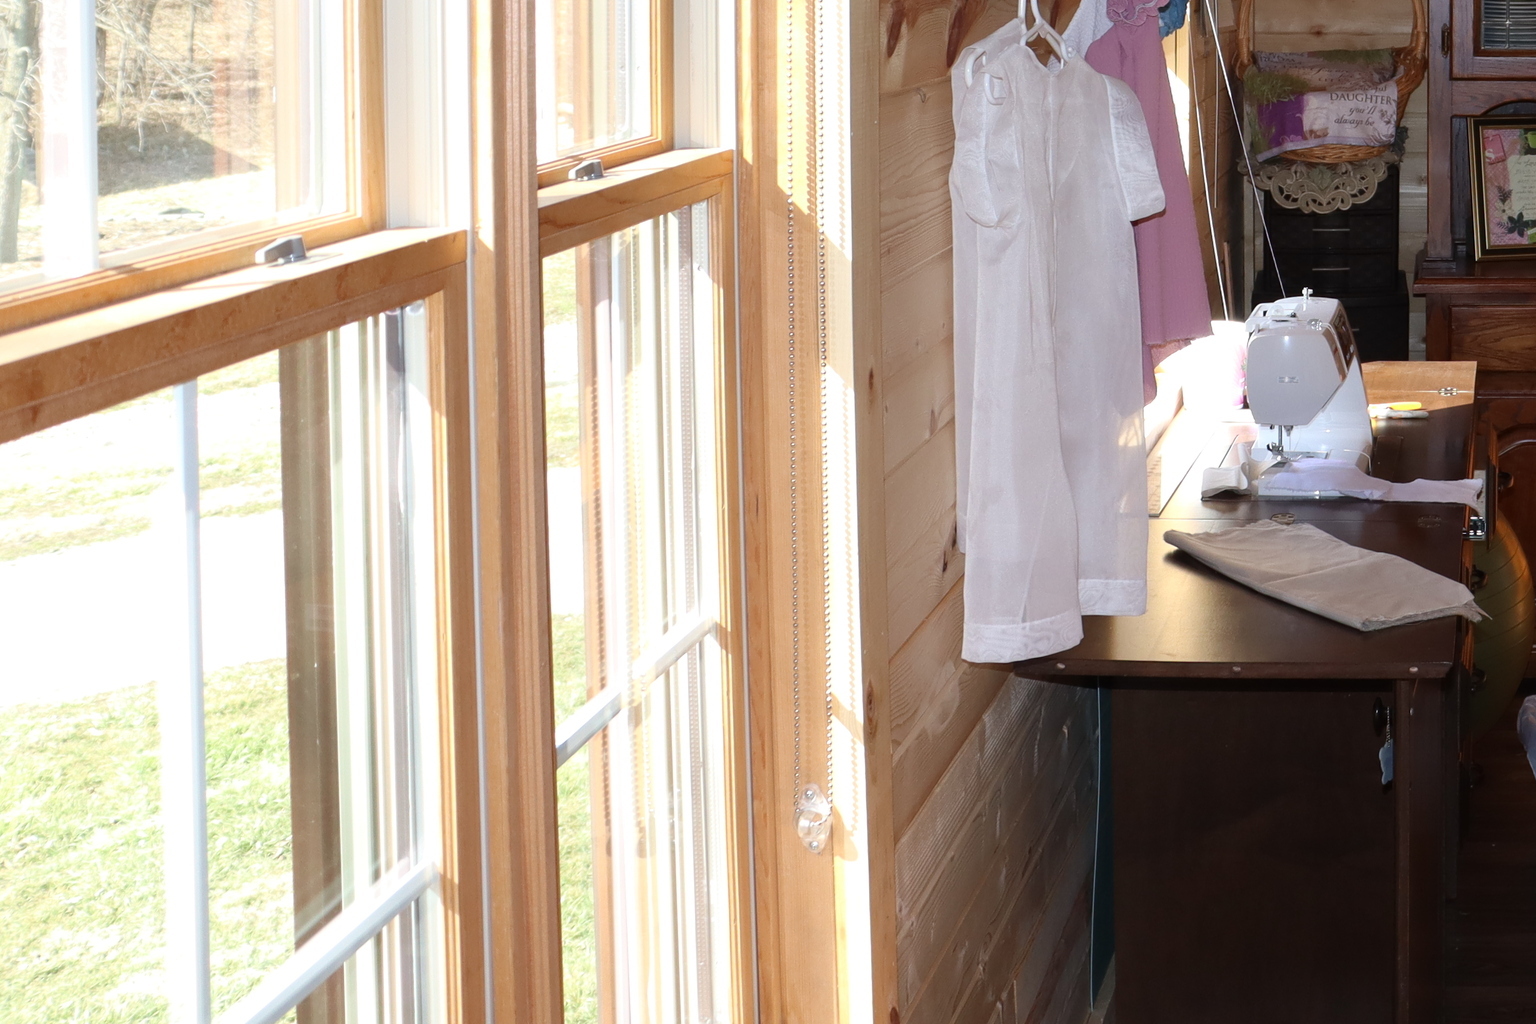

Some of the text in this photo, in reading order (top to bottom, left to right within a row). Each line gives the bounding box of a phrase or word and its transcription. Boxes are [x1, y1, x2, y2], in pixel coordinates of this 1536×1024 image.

[1329, 92, 1393, 106] DAUGHTER
[1349, 106, 1378, 117] you'll
[1334, 115, 1375, 129] always be
